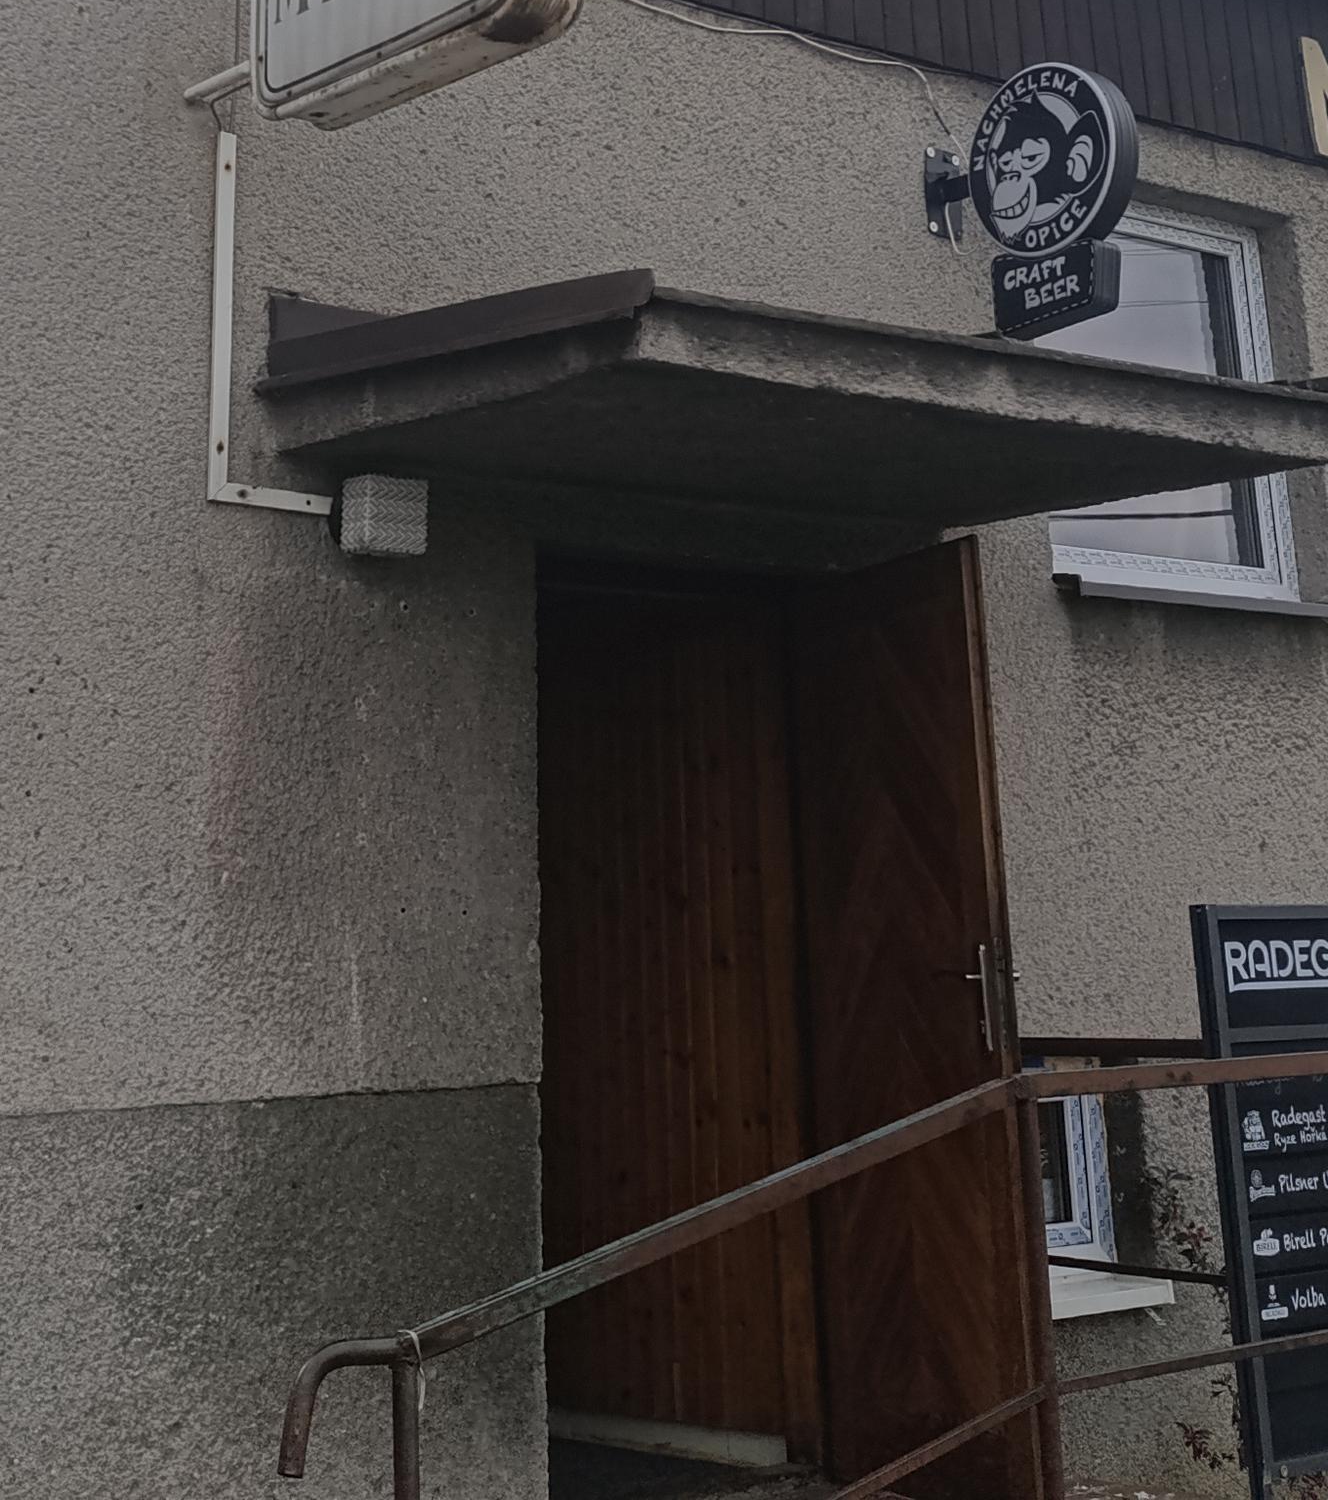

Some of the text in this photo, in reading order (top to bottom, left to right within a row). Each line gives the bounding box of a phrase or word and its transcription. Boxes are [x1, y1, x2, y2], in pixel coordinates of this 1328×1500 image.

[1003, 256, 1066, 290] CRAFT
[1024, 274, 1080, 310] BEER
[1271, 1104, 1326, 1131] Radegast
[1278, 1173, 1319, 1193] Pilsner
[1283, 1229, 1316, 1252] Birell
[1291, 1285, 1326, 1311] Volba
